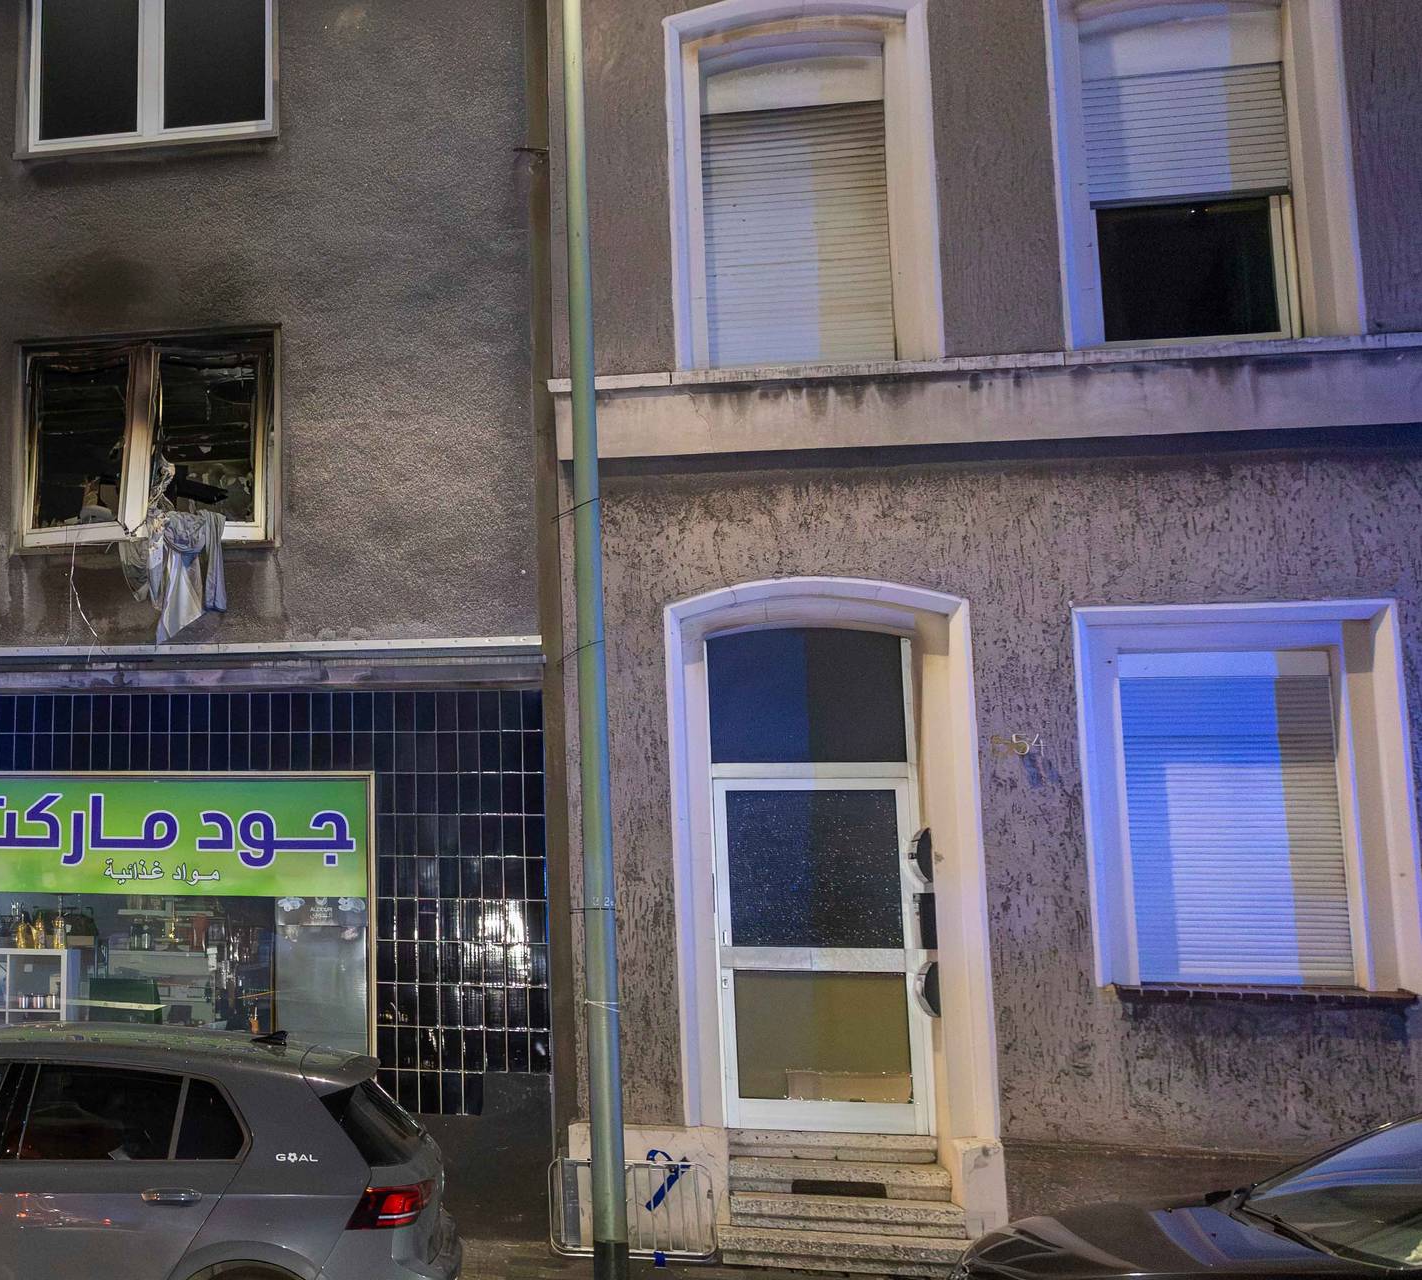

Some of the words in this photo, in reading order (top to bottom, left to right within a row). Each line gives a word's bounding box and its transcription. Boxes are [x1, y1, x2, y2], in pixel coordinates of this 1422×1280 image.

[1011, 733, 1046, 757] 54
[196, 809, 356, 869] جود
[103, 857, 165, 885] غذائية
[172, 863, 221, 886] مواد
